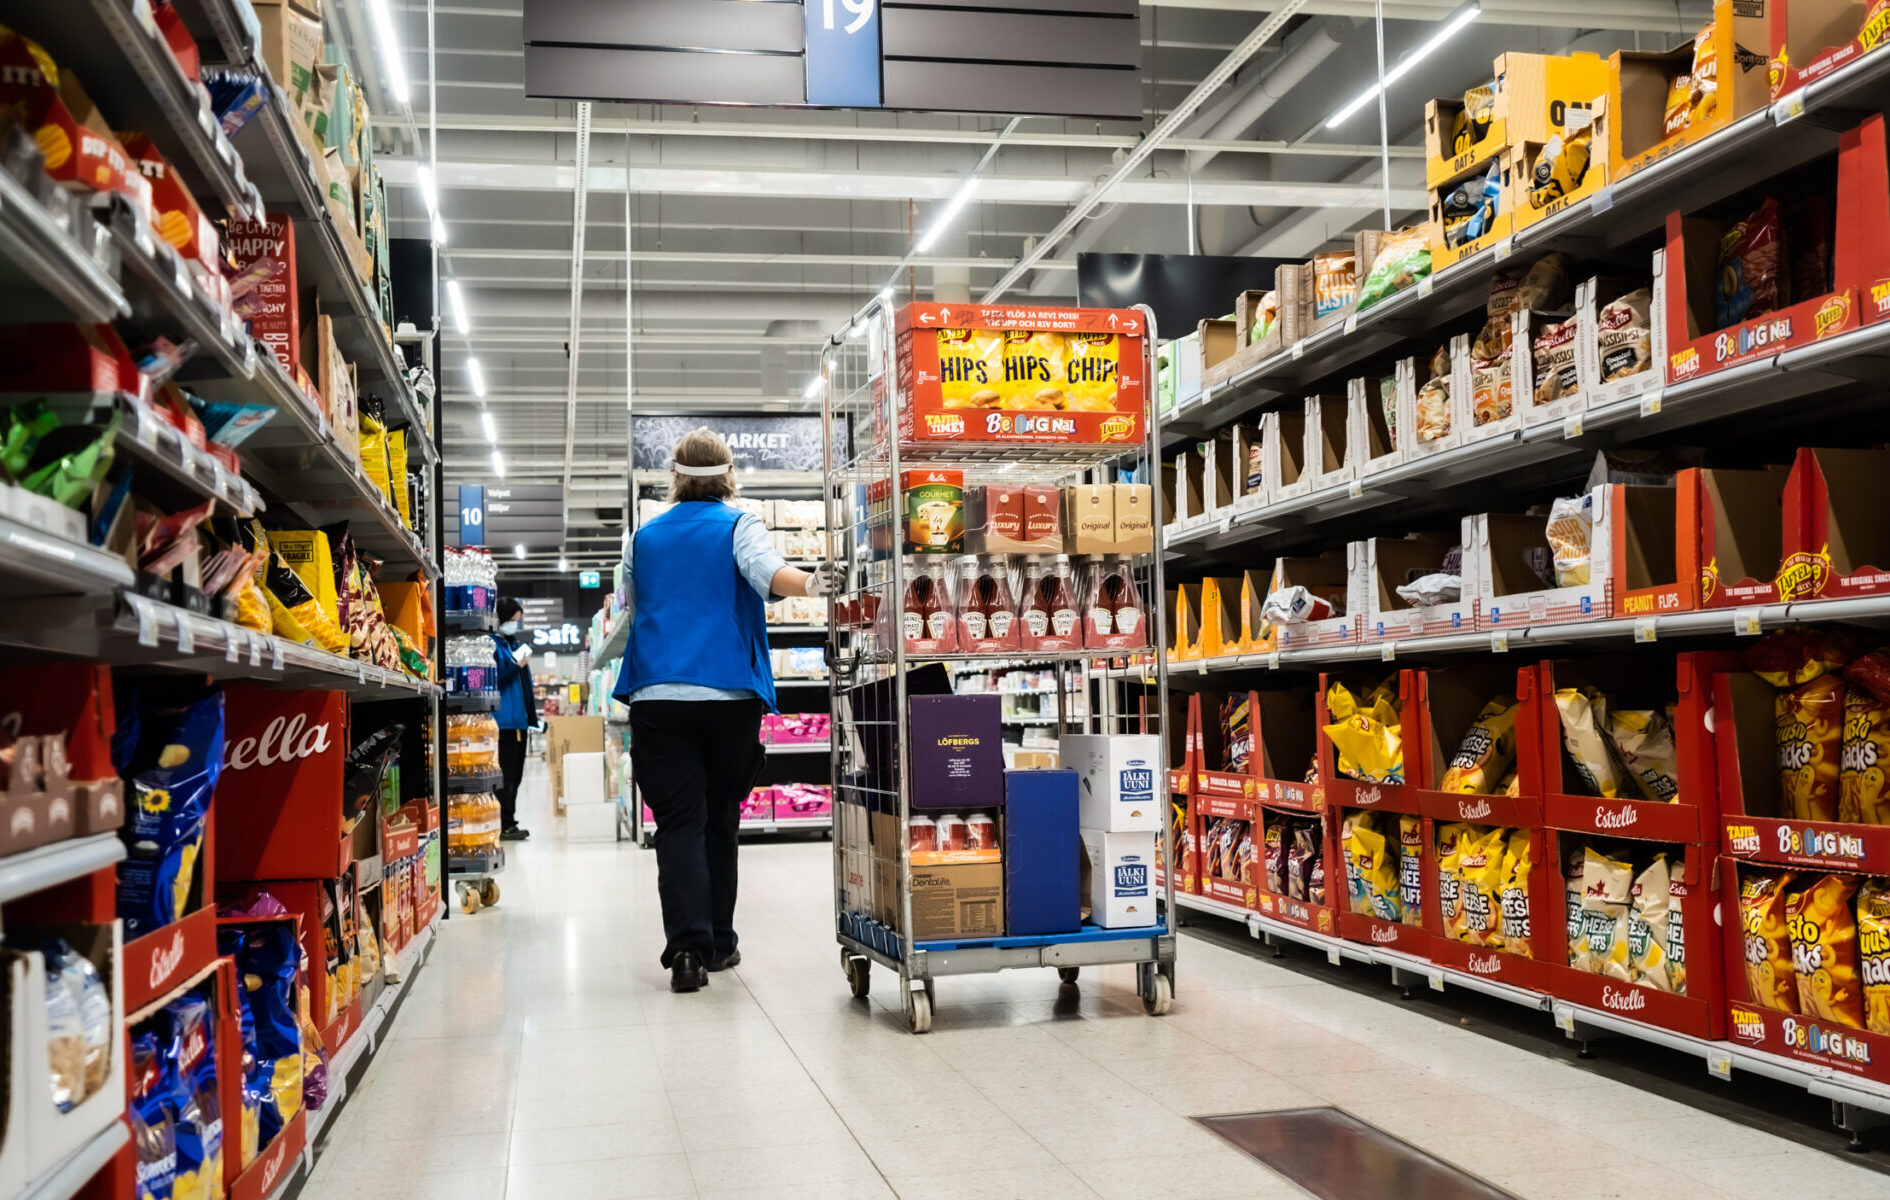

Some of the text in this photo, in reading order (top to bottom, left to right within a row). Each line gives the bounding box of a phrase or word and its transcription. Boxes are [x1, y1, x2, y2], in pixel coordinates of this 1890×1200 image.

[823, 0, 874, 34] 19
[1808, 56, 1832, 75] ORIGINAL
[1832, 44, 1855, 63] SNACKS
[229, 237, 285, 257] HAPPY
[1019, 319, 1035, 328] OCH
[940, 356, 988, 384] HIPS
[1002, 355, 1051, 382] HIPS
[930, 419, 965, 434] TIME!
[919, 490, 954, 498] GOURMET
[461, 507, 482, 525] 10
[991, 520, 1020, 531] Luxury
[1028, 520, 1058, 532] Luxury
[1082, 522, 1110, 531] Original
[1120, 521, 1149, 531] Original
[1549, 518, 1585, 537] SOUR
[1777, 564, 1812, 596] TAFFEL
[1848, 575, 1869, 586] ORIGINAL
[1870, 574, 1890, 584] SNACK
[1725, 584, 1772, 597] THE ORIGINAL SNACKS
[1624, 592, 1680, 613] PEANUT FLIPS
[1781, 741, 1813, 771] acks
[1123, 770, 1150, 781] JÄLKI
[1124, 780, 1150, 789] UUNI
[1355, 786, 1382, 804] Estrella
[1458, 799, 1492, 819] Estrella
[1595, 804, 1638, 828] Estrella
[1732, 834, 1761, 851] TIME!
[1117, 866, 1145, 877] JÄLKI
[1118, 876, 1144, 885] UUNI
[1371, 924, 1398, 943] Estrella
[1468, 953, 1501, 974] Estrella
[1602, 985, 1646, 1011] Estrella
[1737, 1022, 1766, 1040] TIME!
